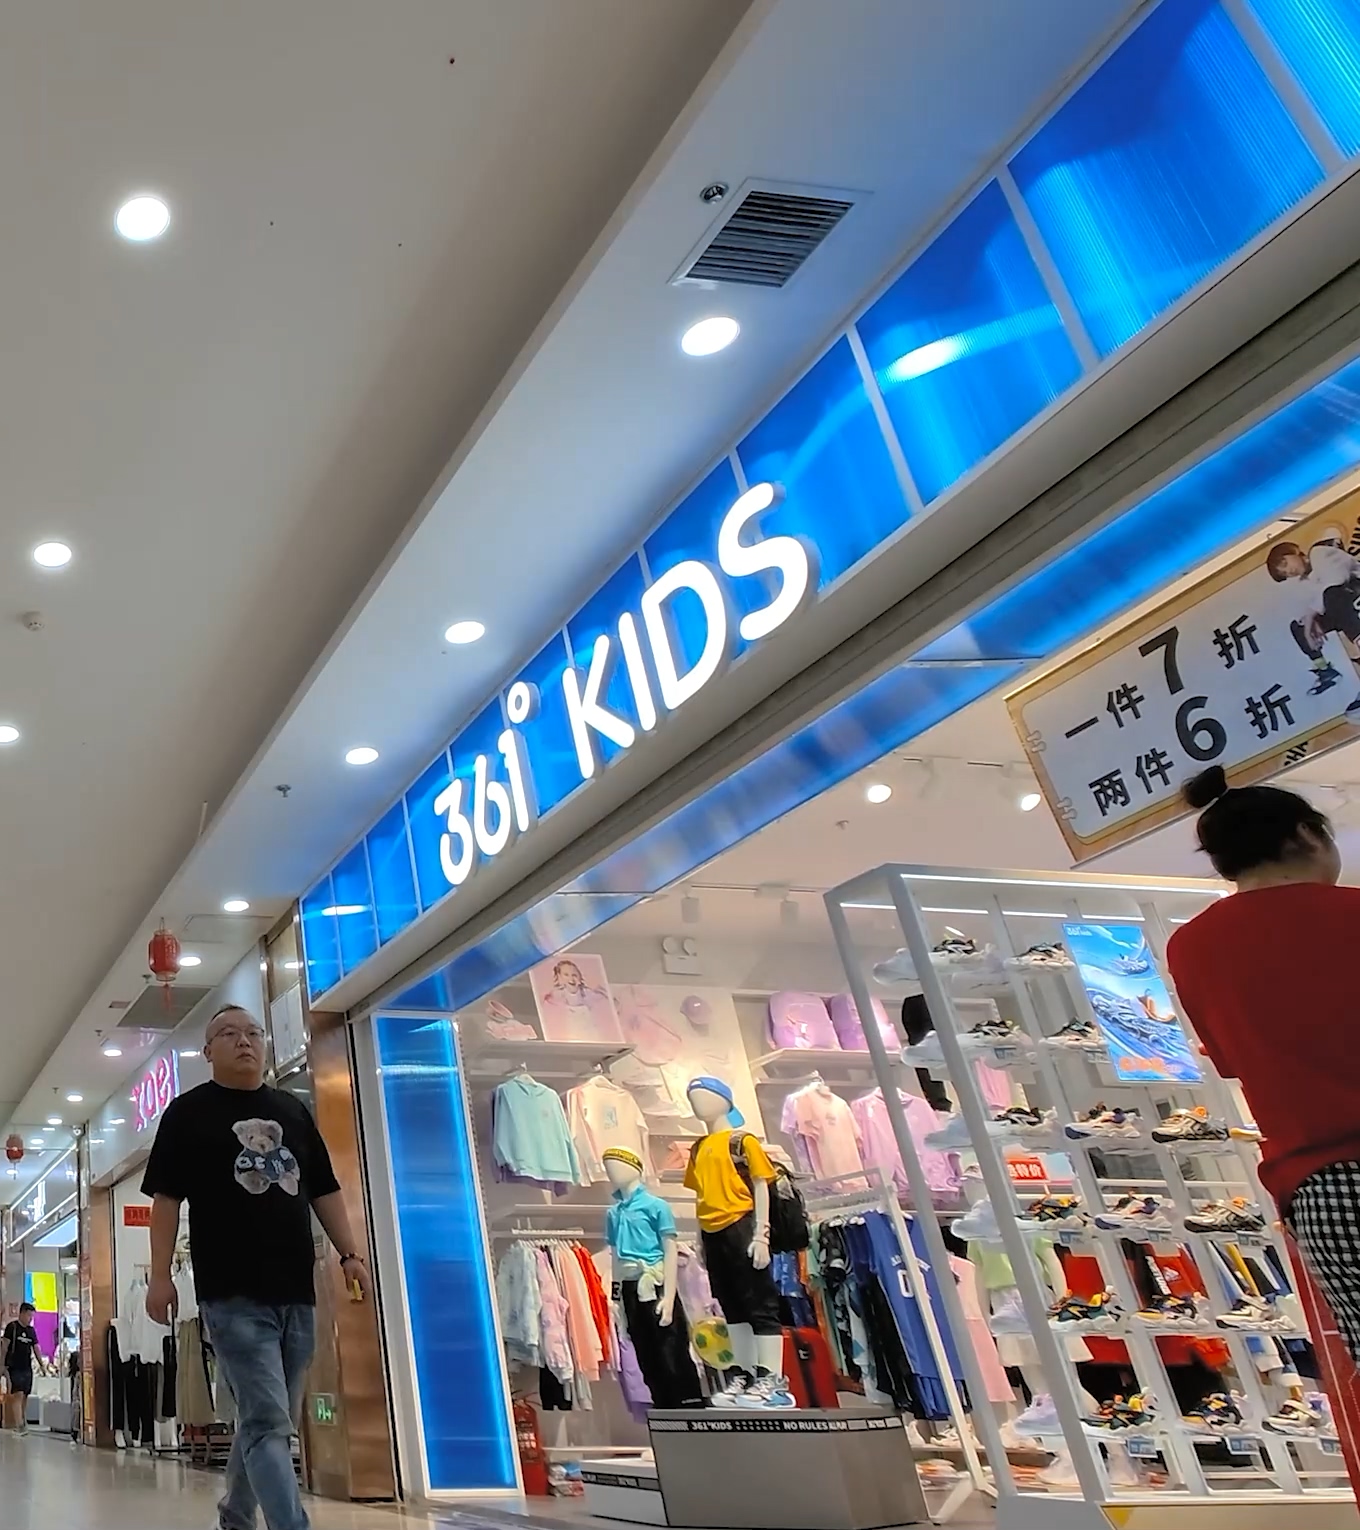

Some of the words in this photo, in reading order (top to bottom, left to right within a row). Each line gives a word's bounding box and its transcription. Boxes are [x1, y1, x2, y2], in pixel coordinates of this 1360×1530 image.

[562, 482, 810, 779] KIDS
[1065, 614, 1260, 740] 一件7折
[1089, 683, 1296, 817] 两件6折
